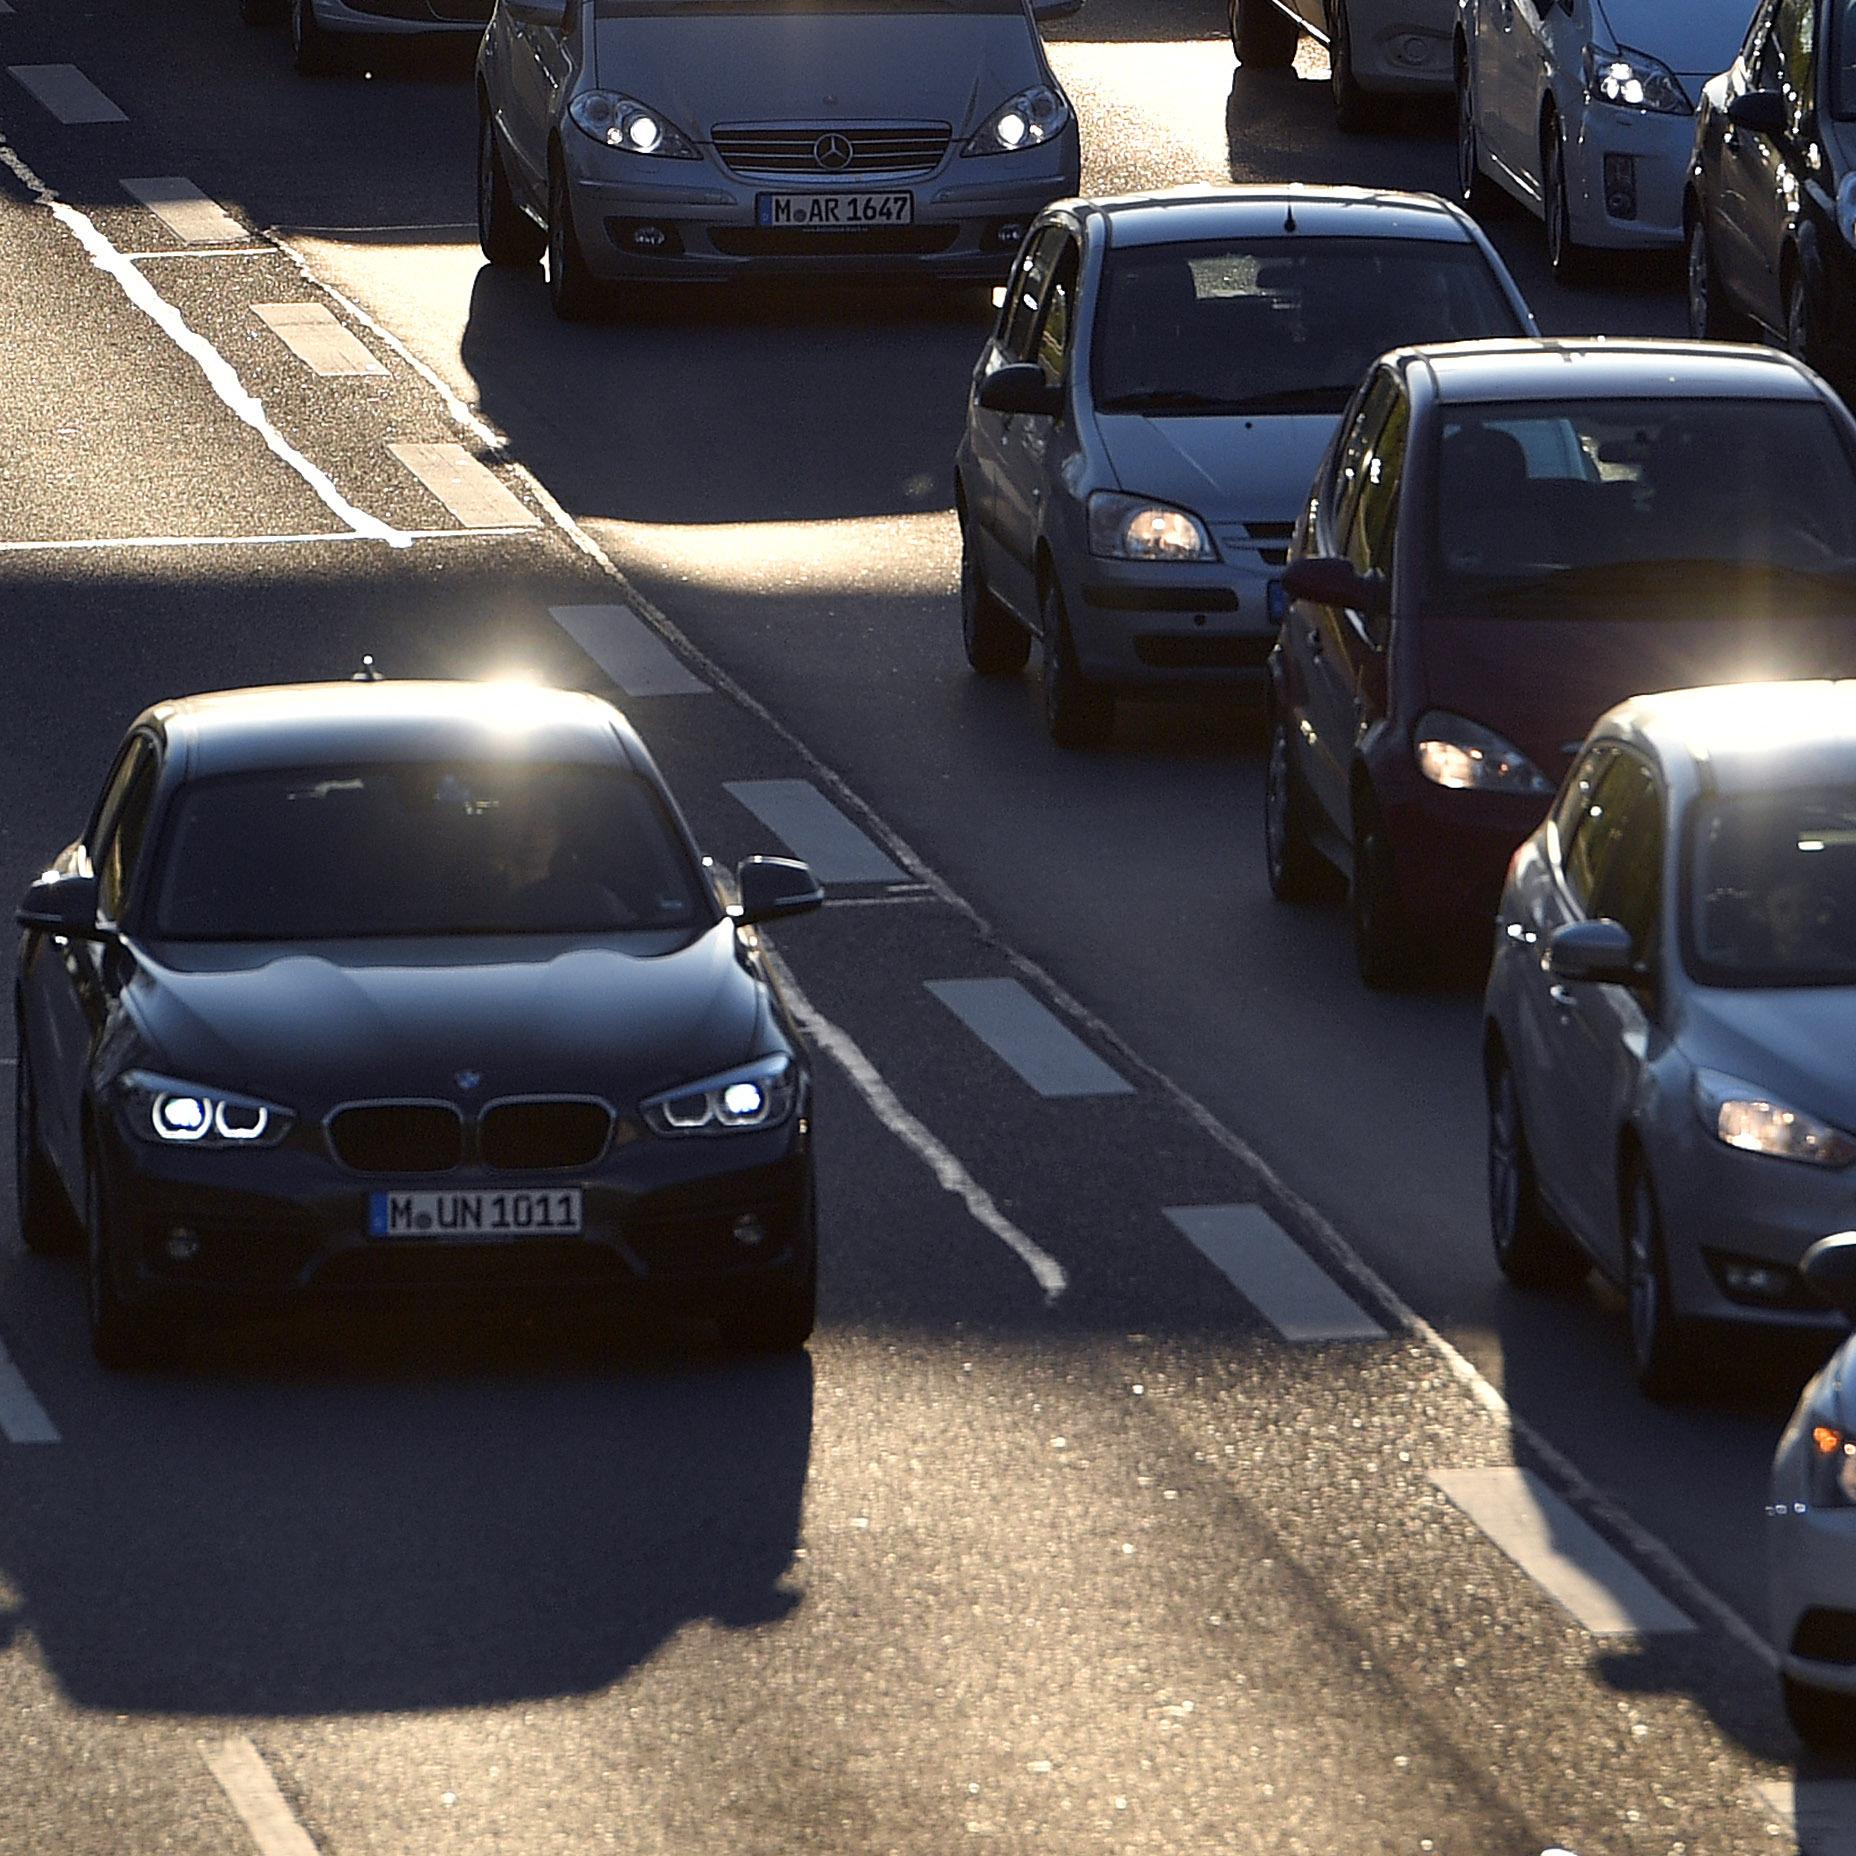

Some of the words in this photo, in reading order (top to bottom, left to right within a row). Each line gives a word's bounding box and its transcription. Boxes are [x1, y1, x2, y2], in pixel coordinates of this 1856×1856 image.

[774, 198, 791, 223] M
[808, 198, 840, 222] AR
[846, 196, 908, 222] 1647
[391, 1198, 412, 1228] M
[437, 1197, 482, 1228] UN
[491, 1196, 576, 1228] 1011
